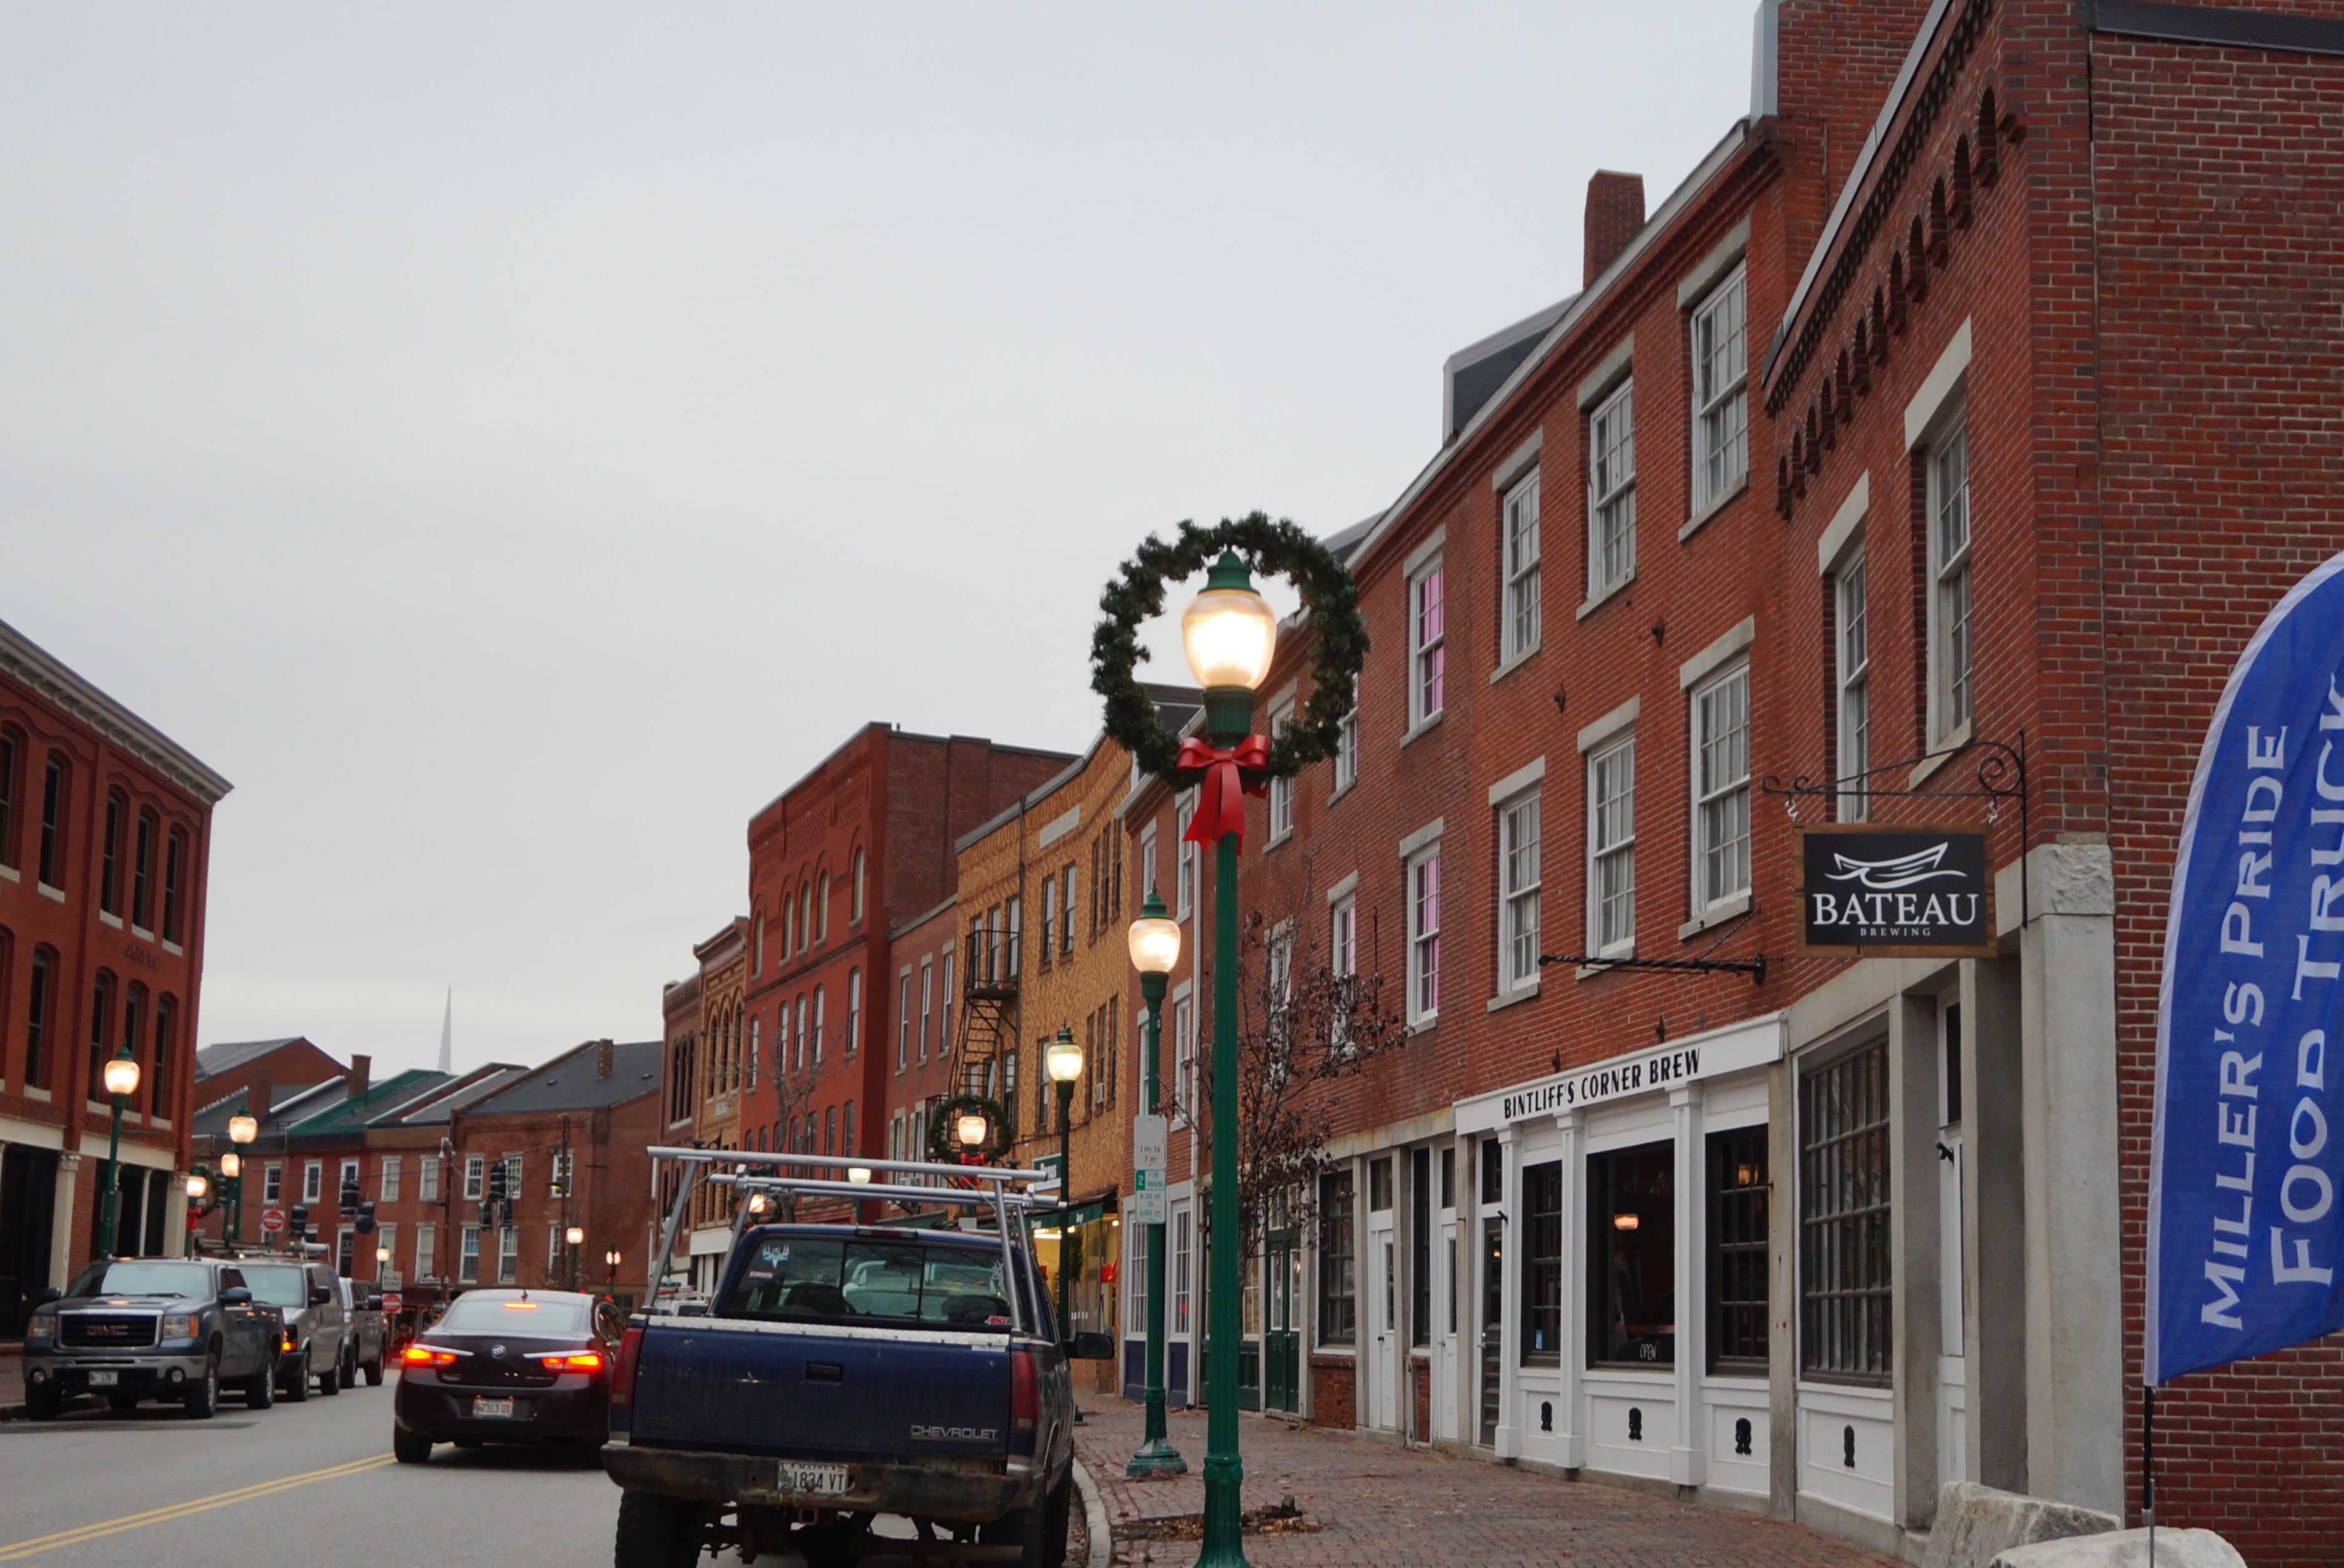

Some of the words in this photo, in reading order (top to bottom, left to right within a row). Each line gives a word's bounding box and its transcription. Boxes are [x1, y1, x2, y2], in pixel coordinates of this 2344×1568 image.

[2220, 725, 2288, 958] PRIDE
[1812, 893, 1979, 925] BATEAU
[1860, 927, 1931, 937] BREWING
[1504, 1080, 1575, 1120] BINTLIFF'S
[1581, 1064, 1641, 1101] CORNER
[1649, 1047, 1700, 1085] BREW
[2201, 981, 2264, 1330] MILLER'S
[2270, 1028, 2333, 1286] FOOD
[1138, 1175, 1144, 1186] 2
[87, 1324, 127, 1336] GMC
[1639, 1343, 1657, 1361] OPEN
[911, 1424, 998, 1439] CHEVROLET
[829, 1473, 844, 1491] VT
